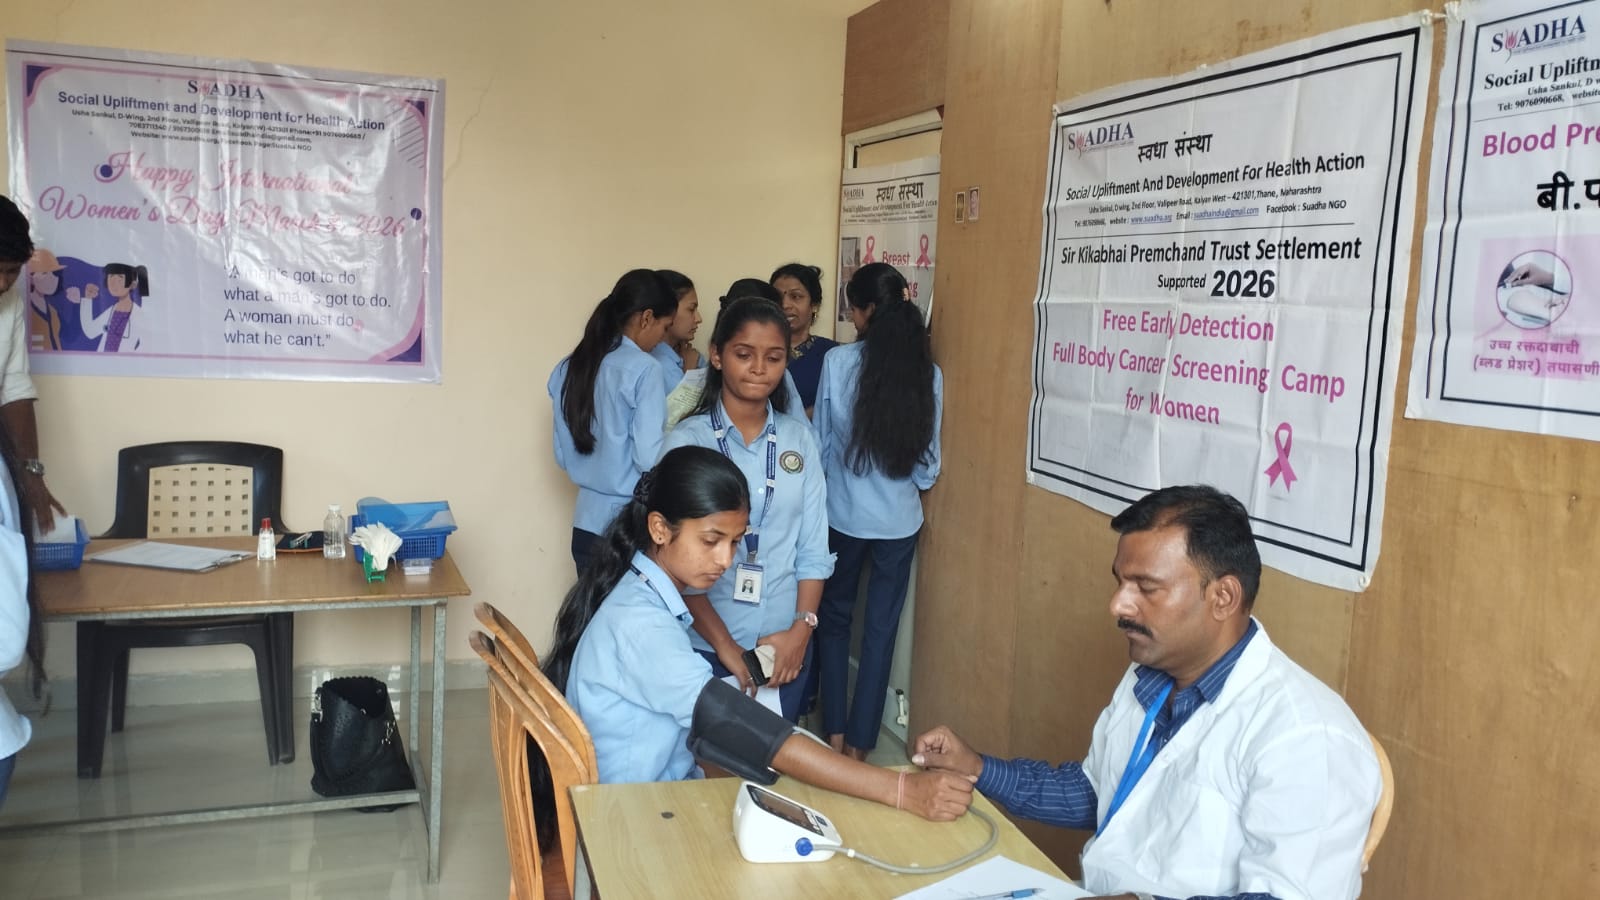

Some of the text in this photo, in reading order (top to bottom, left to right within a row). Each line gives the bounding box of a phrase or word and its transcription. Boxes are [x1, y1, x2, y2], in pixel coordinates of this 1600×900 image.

[1484, 66, 1534, 91] Social
[1528, 86, 1547, 96] Usha
[1585, 77, 1593, 86] D
[58, 91, 385, 130] Social Upliftment and Development for Health Action
[1498, 102, 1512, 111] Tel:
[1138, 141, 1168, 163] स्वधा
[1174, 131, 1213, 158] संस्था
[1483, 124, 1556, 157] Blood
[94, 152, 193, 192] Happy
[1066, 152, 1365, 201] Social Upliftment And Development For Health Action
[39, 186, 160, 221] Women's
[355, 215, 405, 237] 2026
[1212, 194, 1226, 203] West
[1302, 201, 1327, 211] Suadha
[1328, 199, 1347, 209] NGO
[882, 251, 910, 265] Breast
[1061, 236, 1362, 265] Sir Kikabhai Premchand Trust Settlement
[293, 269, 315, 284] got
[320, 271, 333, 283] to
[338, 271, 356, 284] do
[1157, 269, 1276, 298] Supported 2026
[224, 287, 392, 308] what a man's got to do.
[224, 308, 354, 326] A woman must do
[1103, 309, 1274, 342] Free Early Detection
[224, 330, 259, 345] what
[264, 331, 281, 345] he
[1053, 342, 1345, 403] Full Body Cancer Screening Camp
[1125, 387, 1220, 425] for Women
